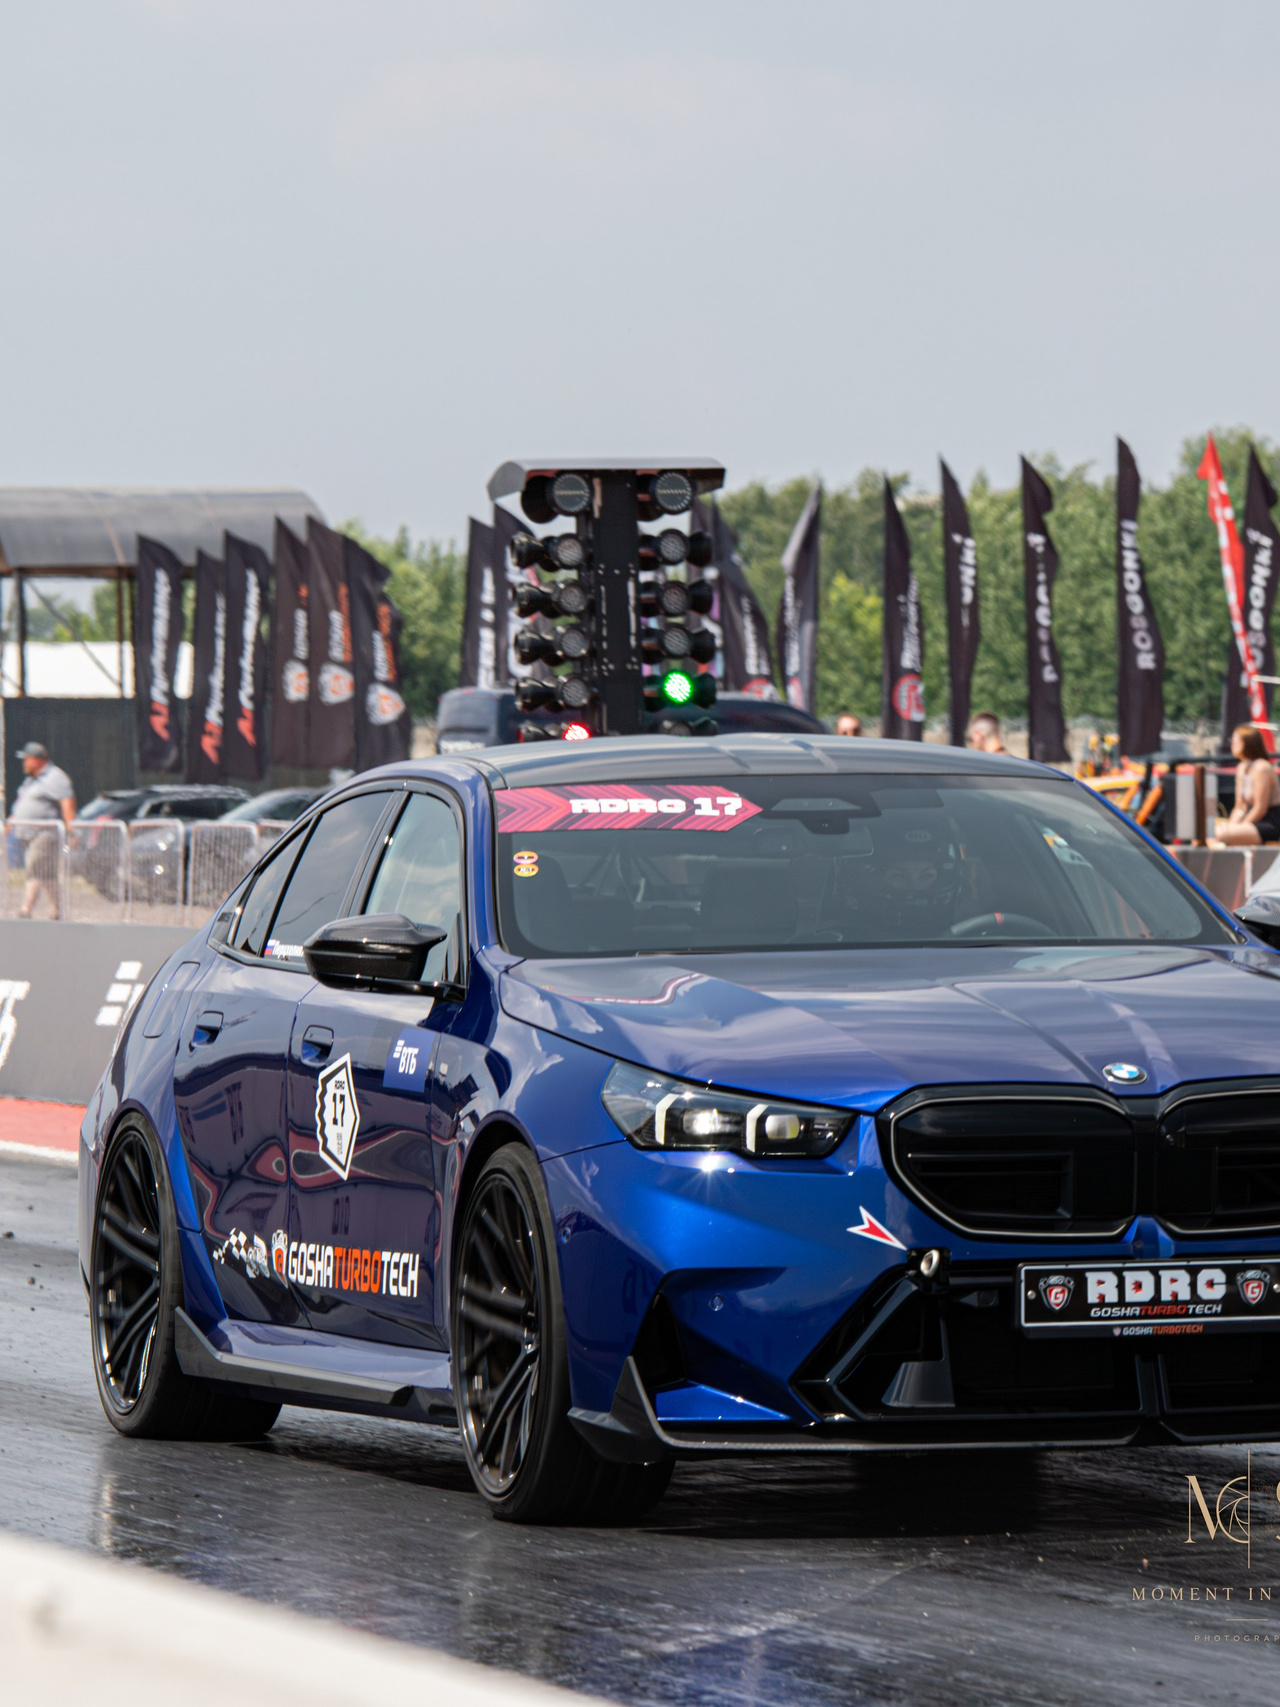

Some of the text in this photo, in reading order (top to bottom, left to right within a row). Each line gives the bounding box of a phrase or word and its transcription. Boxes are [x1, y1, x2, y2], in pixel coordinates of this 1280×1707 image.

[569, 796, 743, 816] RDRC 17
[398, 1046, 419, 1075] ВТБ
[332, 1092, 346, 1127] 17
[288, 1241, 420, 1298] GOSHATURBOTECH
[1085, 1268, 1227, 1304] RDRC
[1090, 1303, 1222, 1318] GOSHATURBOTECH
[1122, 1324, 1204, 1336] GOSHATURBOTECH
